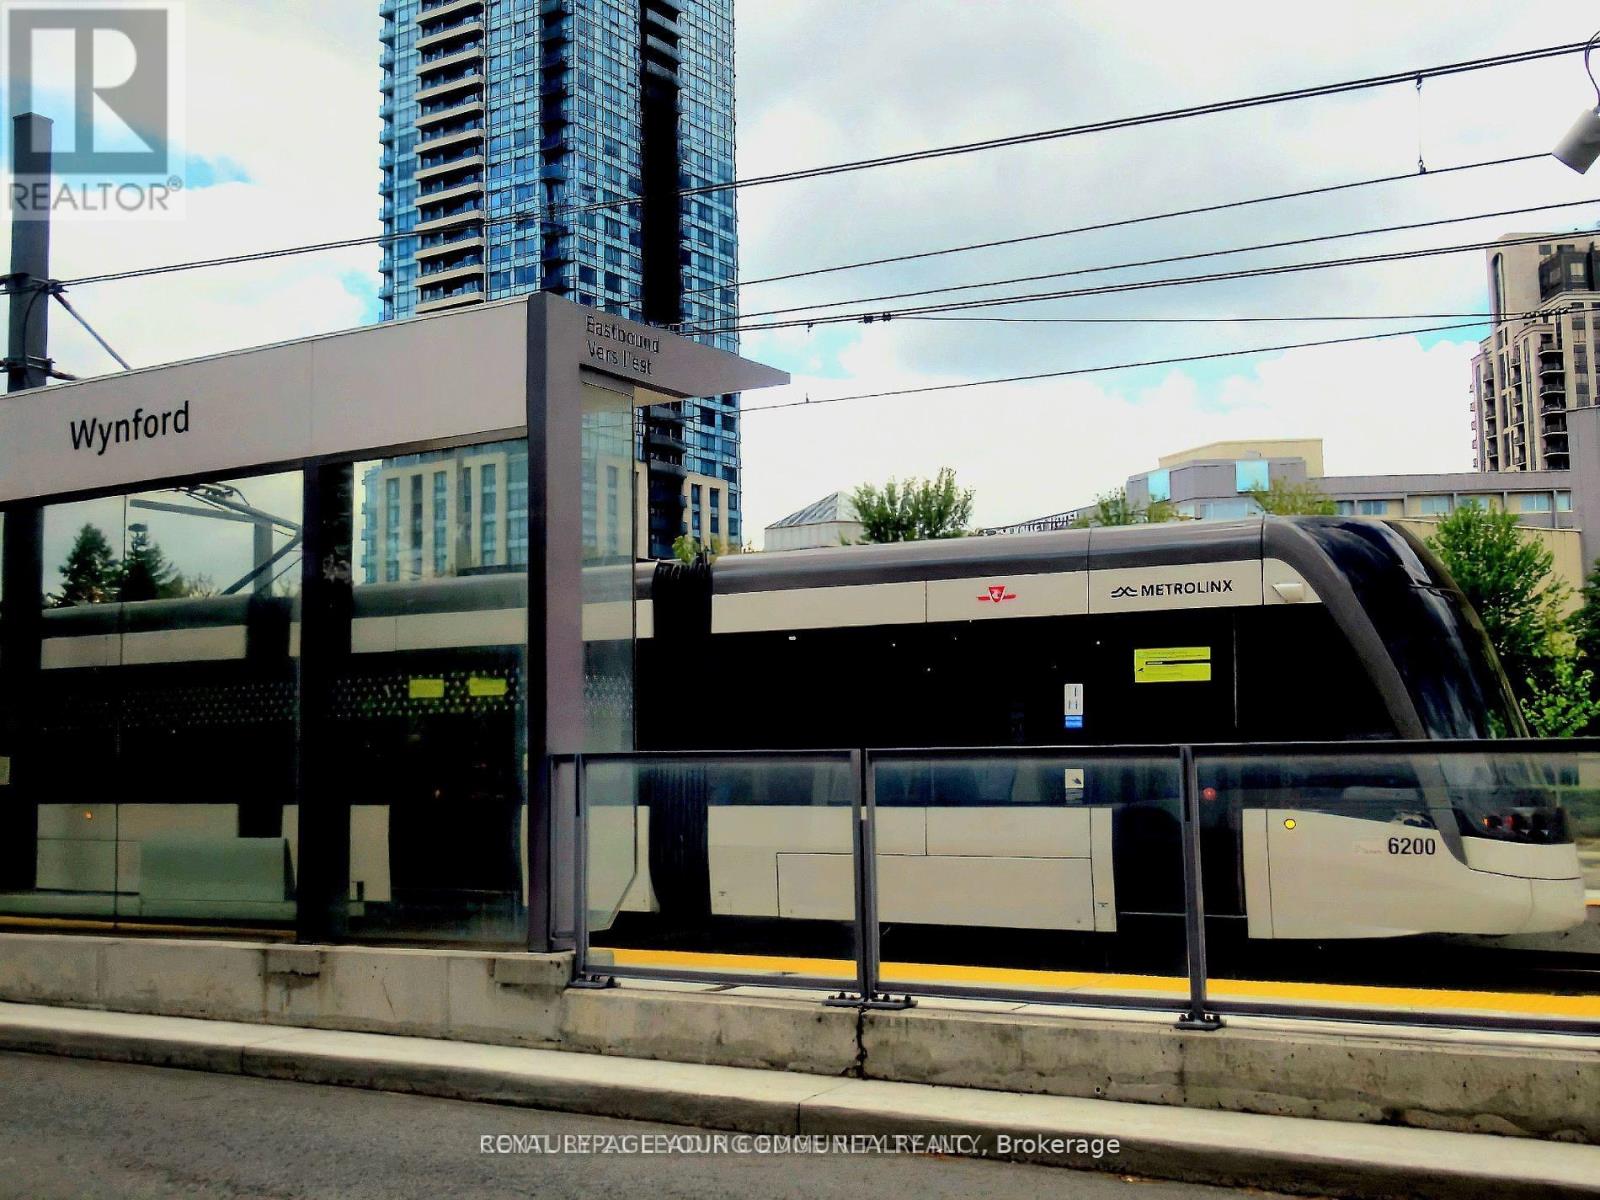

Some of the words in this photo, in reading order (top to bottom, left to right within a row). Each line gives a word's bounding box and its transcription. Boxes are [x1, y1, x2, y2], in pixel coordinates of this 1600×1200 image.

[586, 314, 660, 353] Eastbound
[587, 339, 618, 365] Vers
[70, 400, 189, 456] Wynford
[1141, 579, 1233, 597] METROLINX
[1388, 837, 1436, 855] 6200
